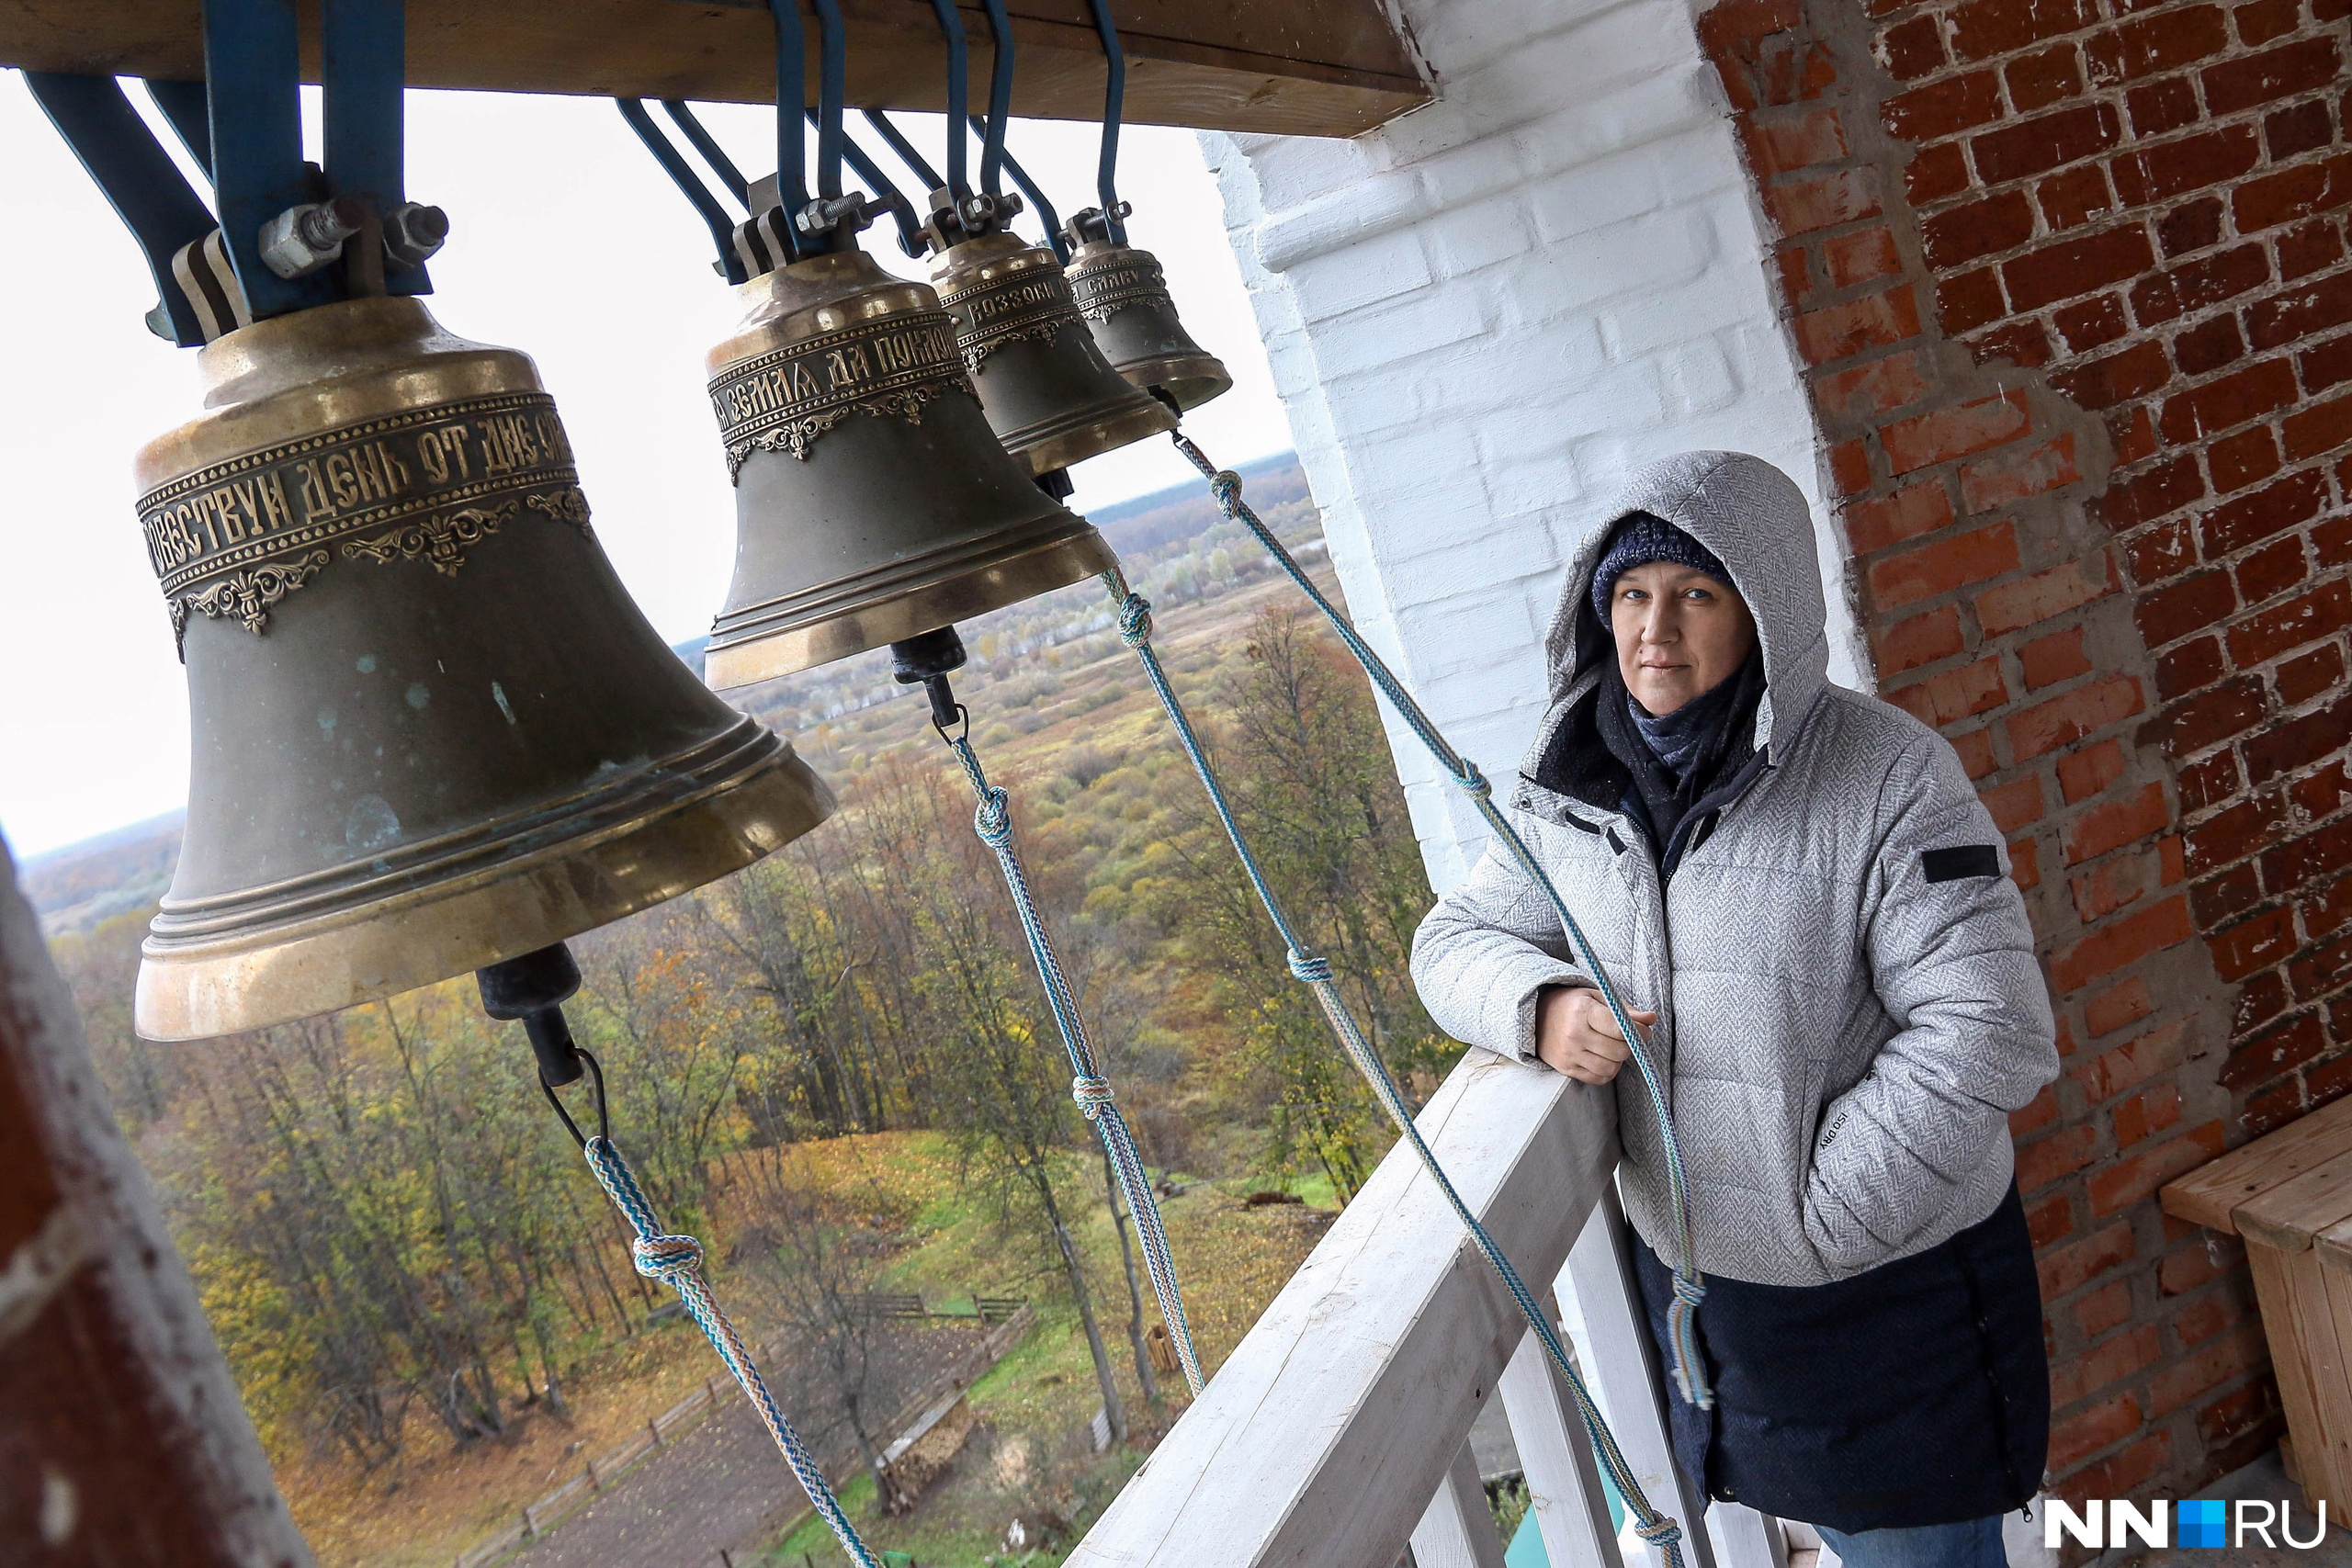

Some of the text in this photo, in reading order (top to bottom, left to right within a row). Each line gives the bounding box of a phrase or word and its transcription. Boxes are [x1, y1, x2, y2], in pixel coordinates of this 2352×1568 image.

[825, 344, 871, 391] ДА
[296, 441, 411, 525] ДЕНЬ
[416, 423, 469, 485] ОТ
[477, 413, 538, 478] ДНЕ
[1819, 1112, 1849, 1150] ISO DRY
